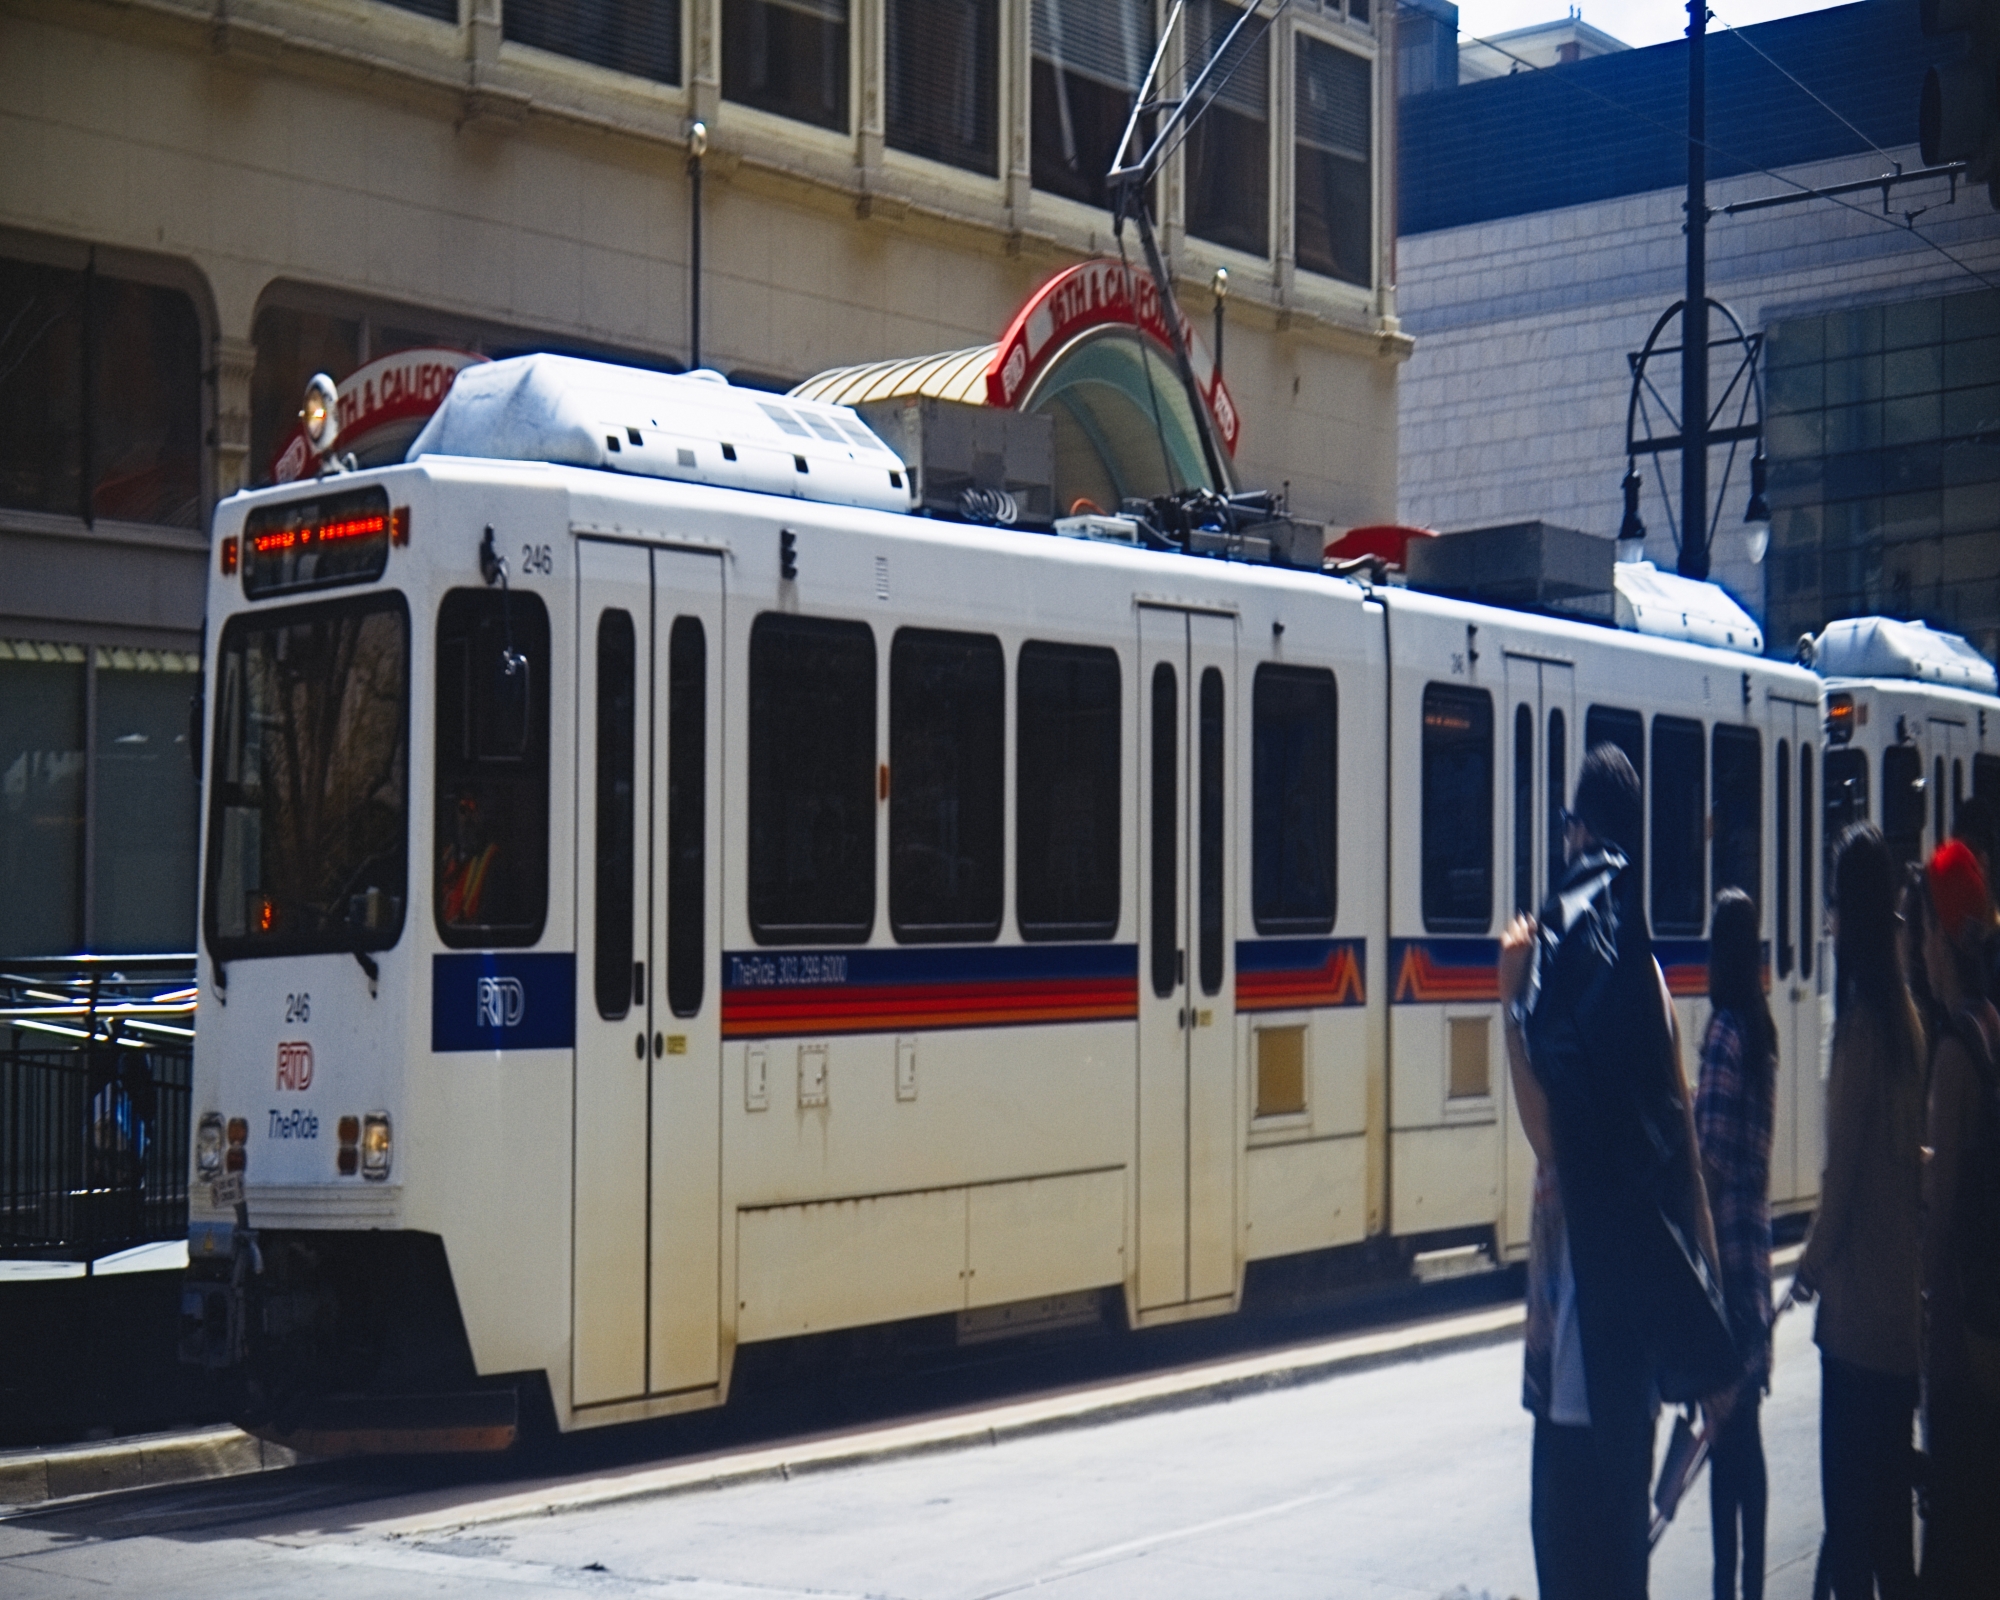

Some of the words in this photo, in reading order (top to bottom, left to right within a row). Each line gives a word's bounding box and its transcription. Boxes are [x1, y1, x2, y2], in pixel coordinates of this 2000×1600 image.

[337, 387, 358, 431] TH
[381, 363, 456, 406] CALIFOR
[522, 543, 554, 575] 246
[285, 992, 311, 1023] 246
[476, 976, 525, 1027] RTD
[276, 1041, 314, 1091] RTD
